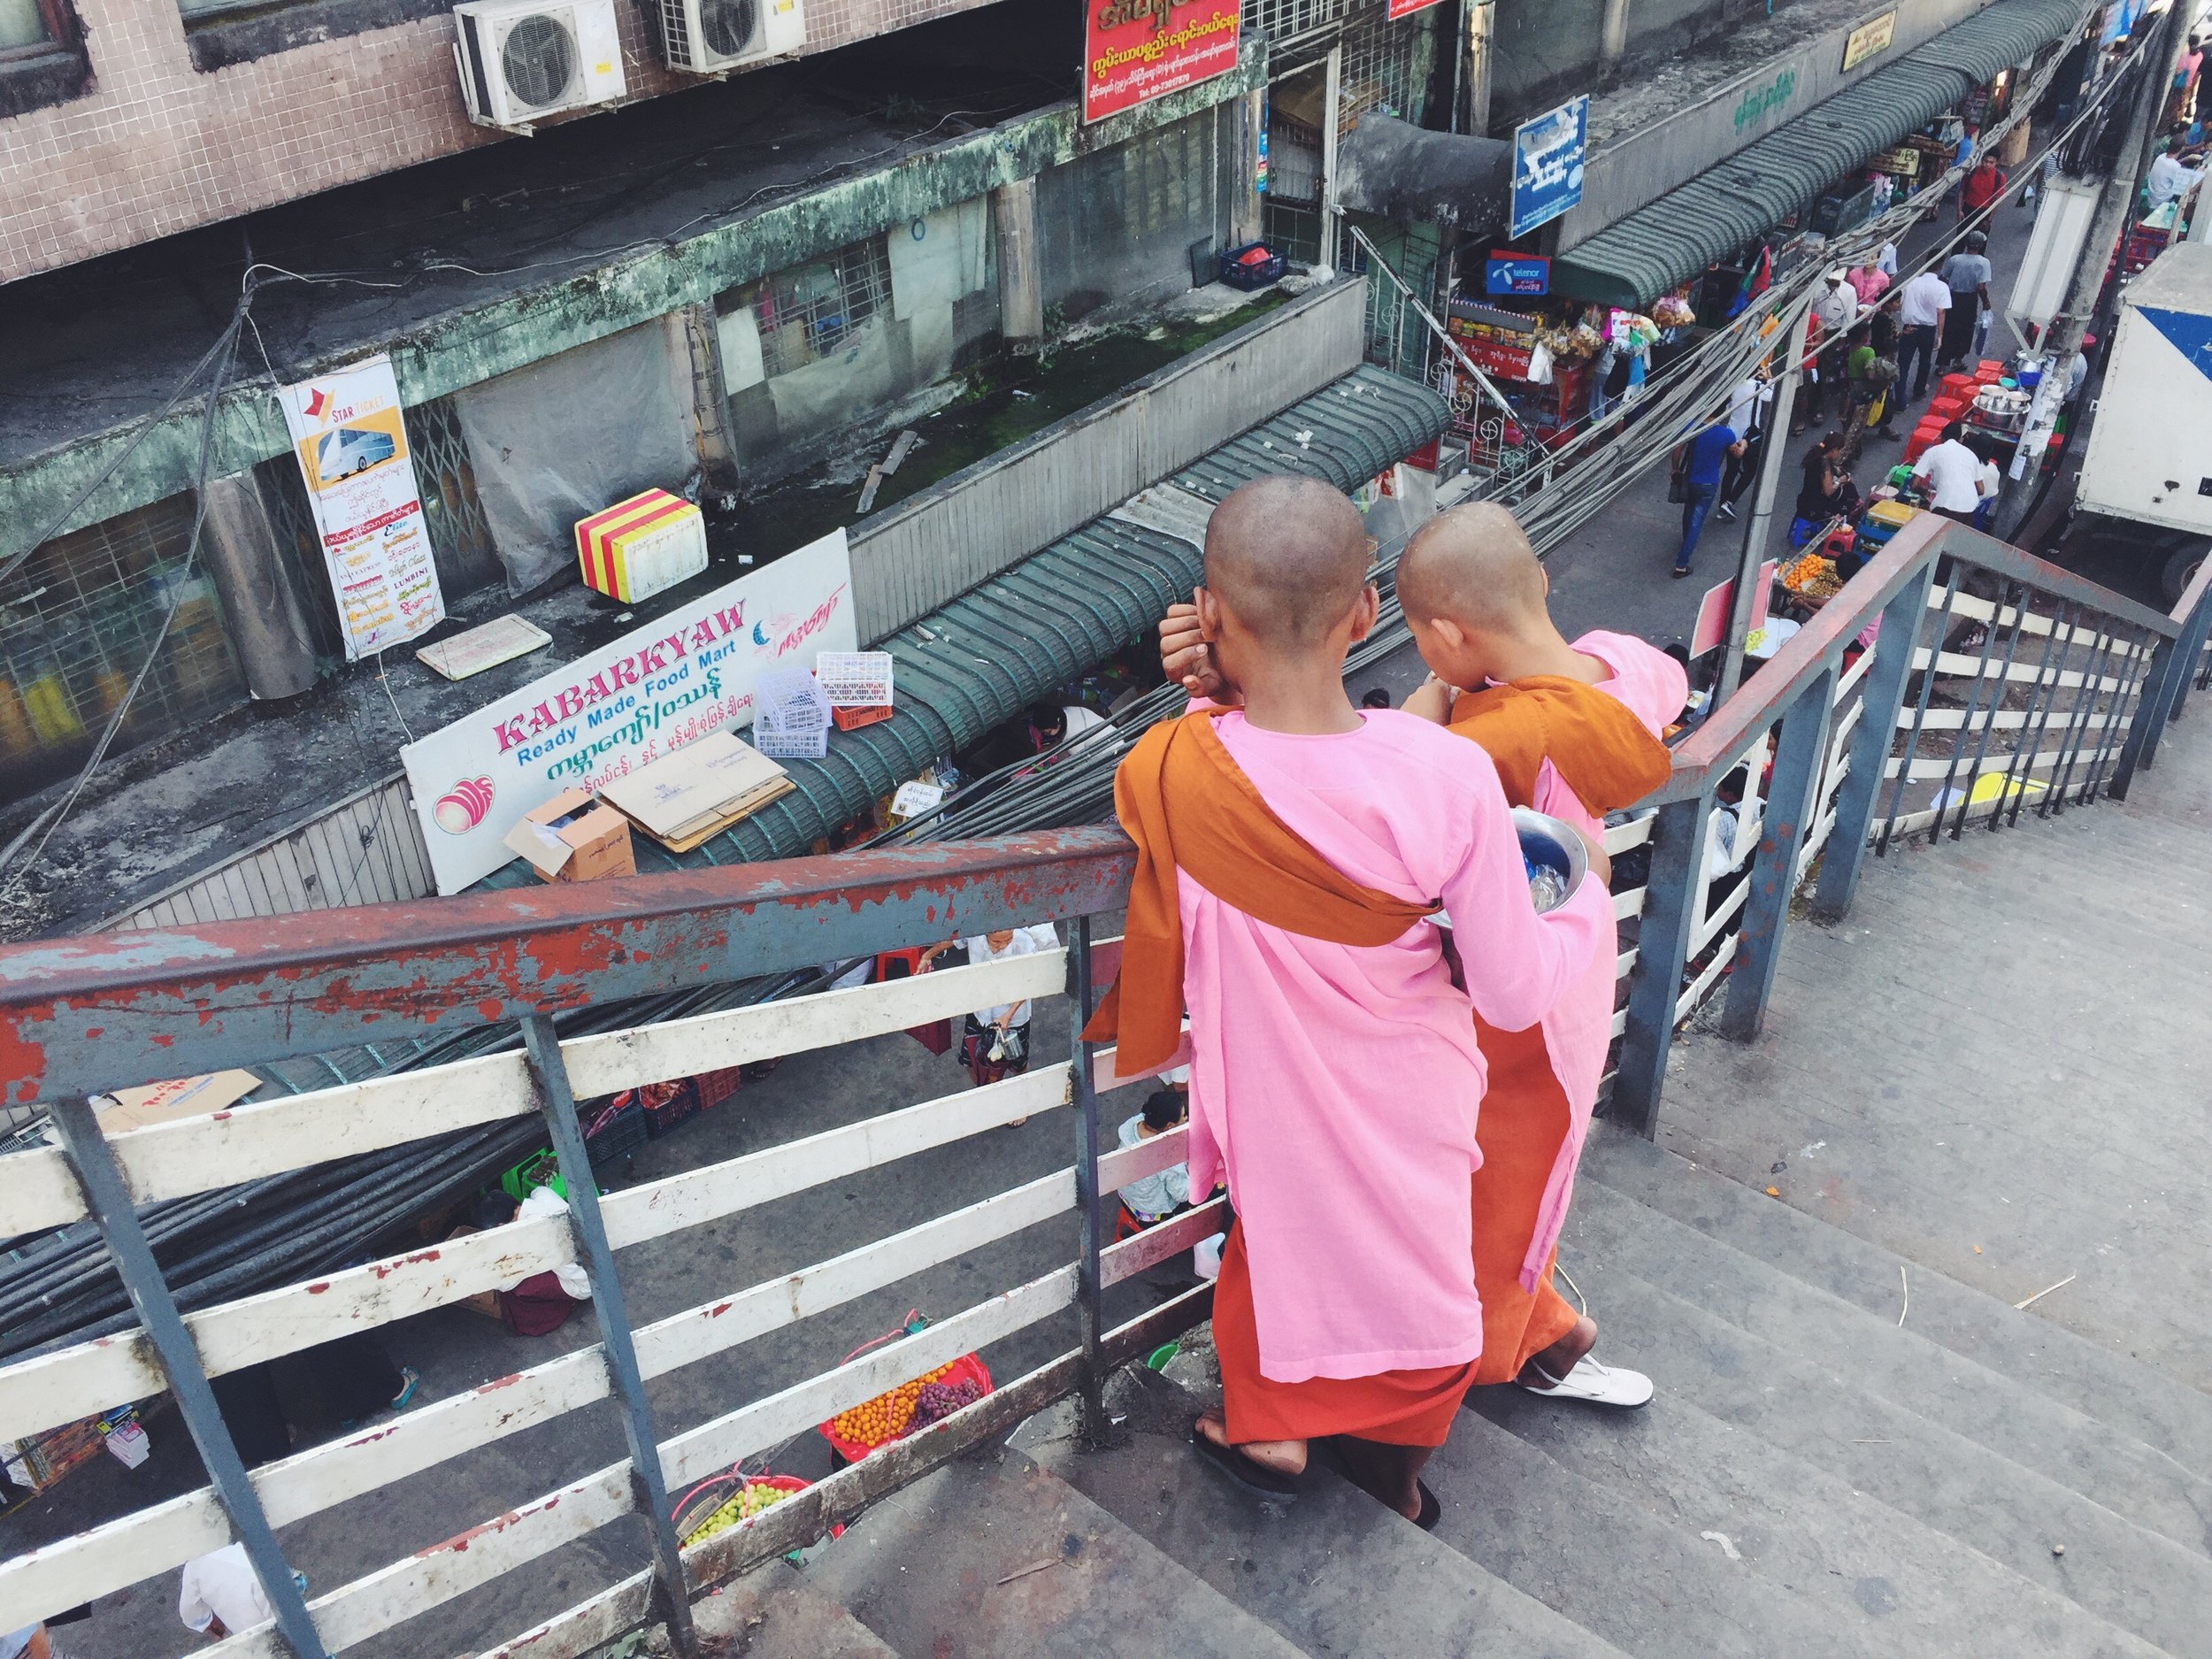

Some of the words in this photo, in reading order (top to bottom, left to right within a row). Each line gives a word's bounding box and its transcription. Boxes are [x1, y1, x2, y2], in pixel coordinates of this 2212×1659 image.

[1513, 268, 1540, 277] telenor
[332, 406, 355, 423] STAR
[355, 396, 384, 414] TICKET
[384, 520, 408, 537] Elite
[393, 566, 429, 589] LUMBINI
[491, 598, 748, 757] KABARKYAW
[517, 726, 578, 767] Ready
[588, 695, 636, 727] Made
[644, 664, 689, 700] Food
[697, 639, 736, 667] Mart
